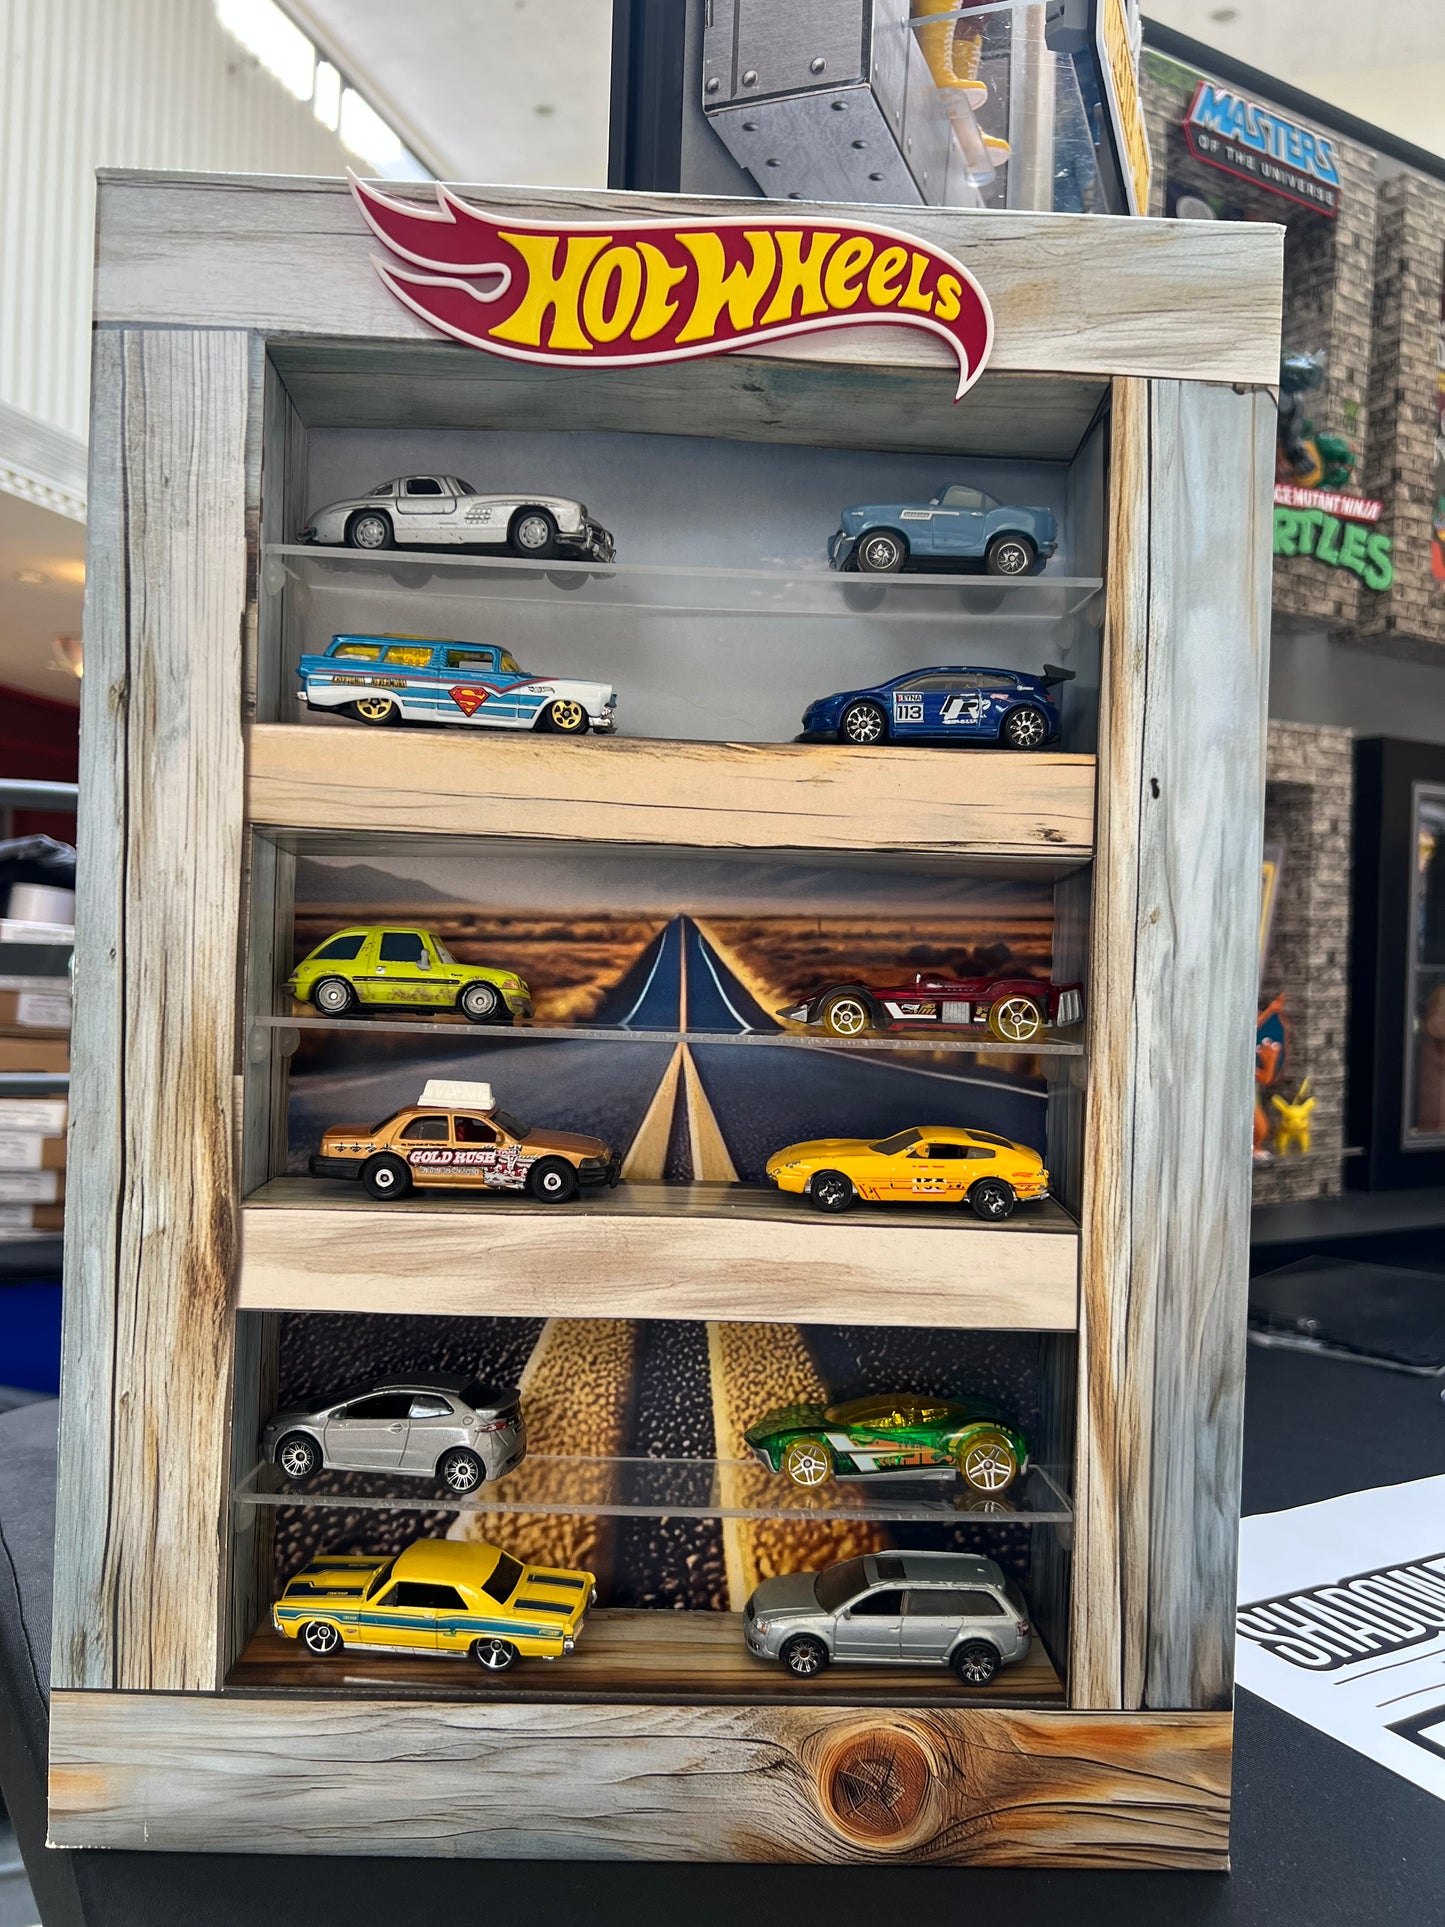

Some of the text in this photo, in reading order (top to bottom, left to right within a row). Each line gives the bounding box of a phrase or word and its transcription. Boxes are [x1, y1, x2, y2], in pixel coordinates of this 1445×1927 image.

[1190, 82, 1341, 188] MASTERS
[1198, 134, 1335, 206] OF THE UNIVERSE
[1292, 488, 1340, 513] MUTANT
[1341, 496, 1380, 520] NINJA
[1273, 507, 1393, 591] RTLES
[897, 705, 922, 720] 113
[409, 1151, 496, 1165] GOLD RUSH
[1236, 1556, 1445, 1667] SHADOW
